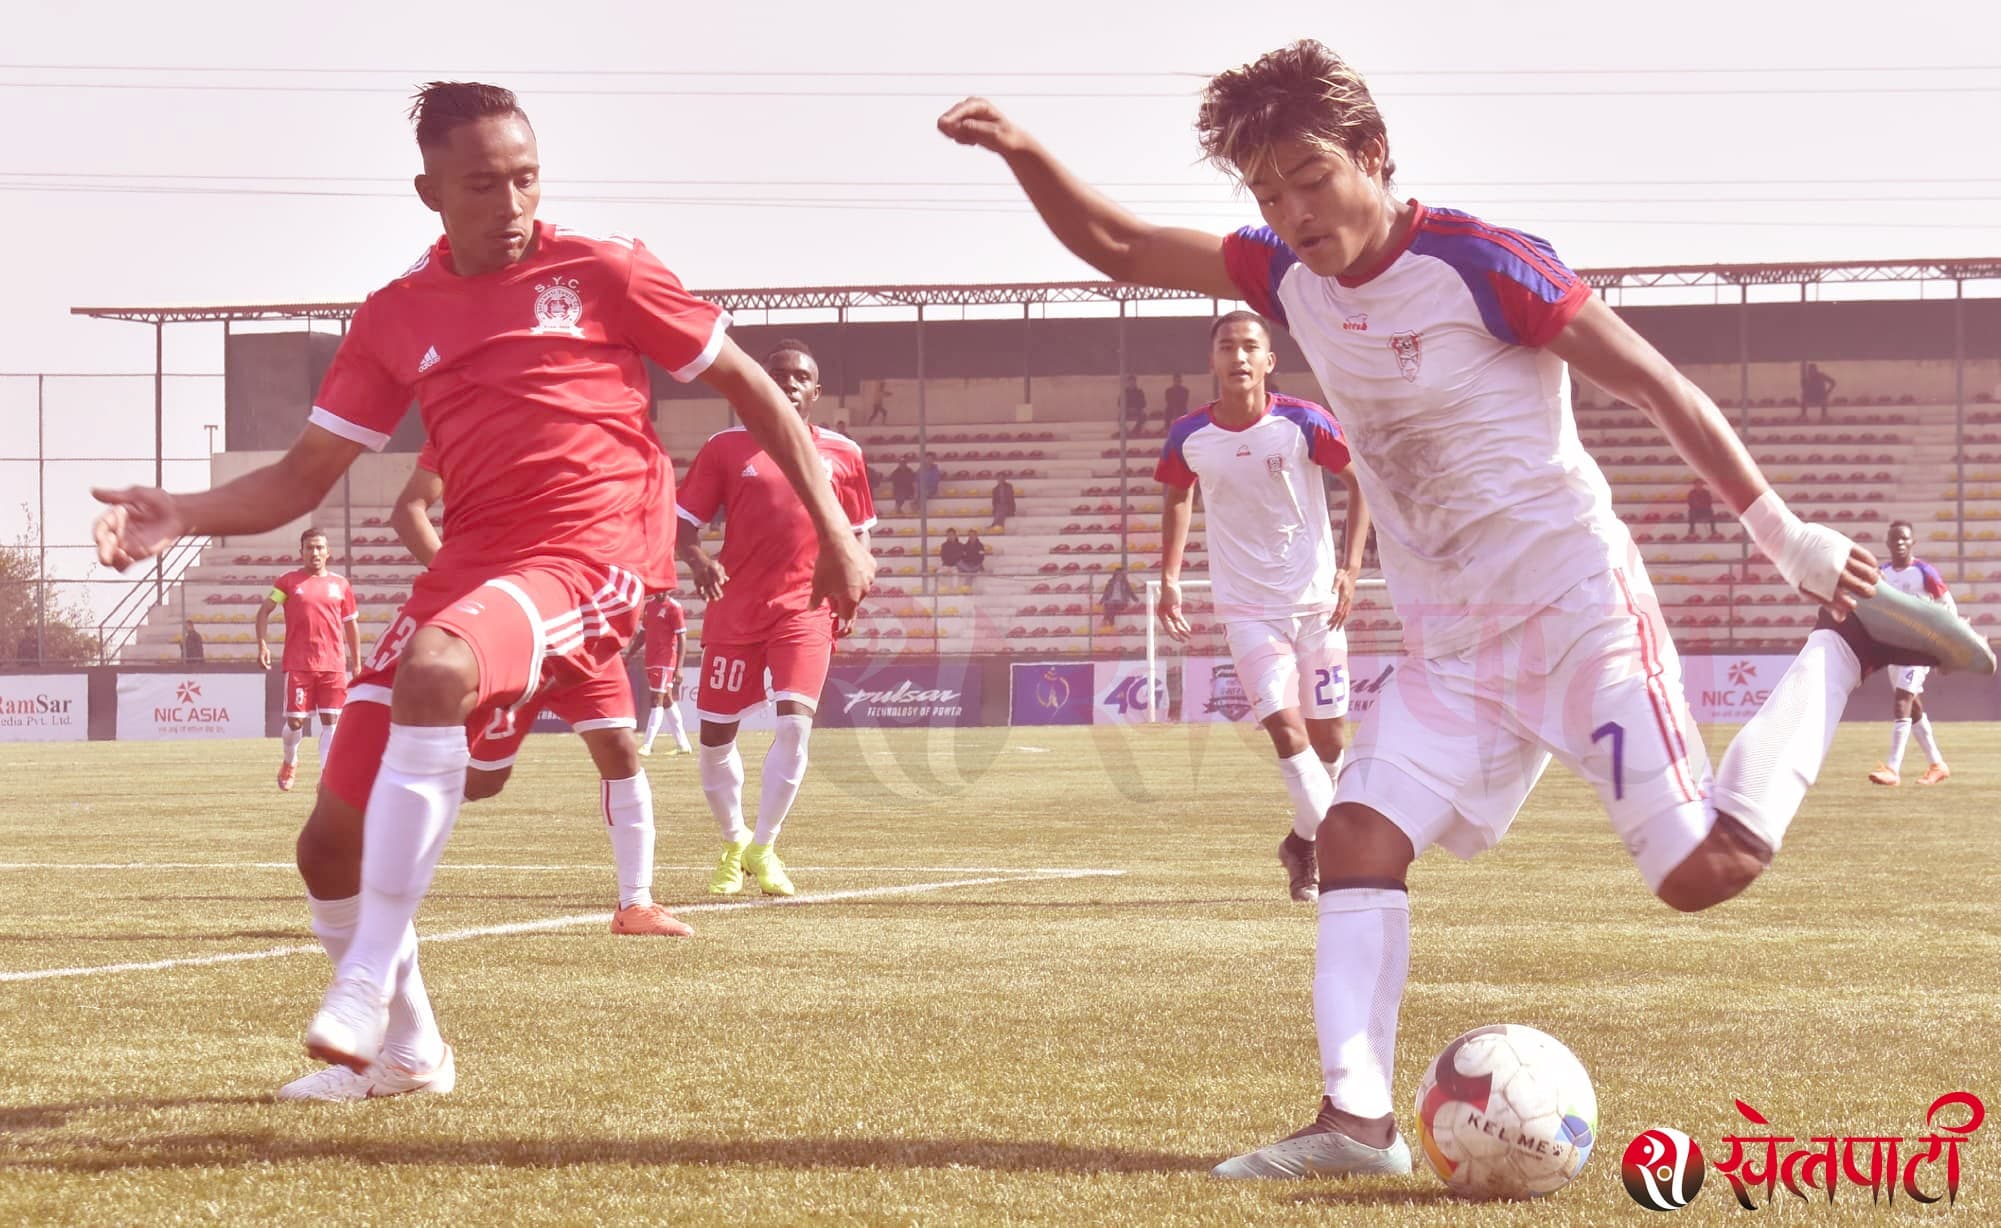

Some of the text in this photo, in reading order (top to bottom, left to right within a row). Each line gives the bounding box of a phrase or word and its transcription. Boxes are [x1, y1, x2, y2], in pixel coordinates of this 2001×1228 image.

[710, 656, 746, 692] 30
[1315, 665, 1345, 706] 25
[843, 680, 961, 714] pulsar
[867, 706, 962, 718] TECHNOLOGY OF POWER
[1103, 676, 1163, 714] 4G
[1702, 690, 1774, 706] NIC AS
[154, 707, 230, 722] NIC ASIA
[1591, 721, 1624, 801] 7
[1468, 1111, 1550, 1155] KELME
